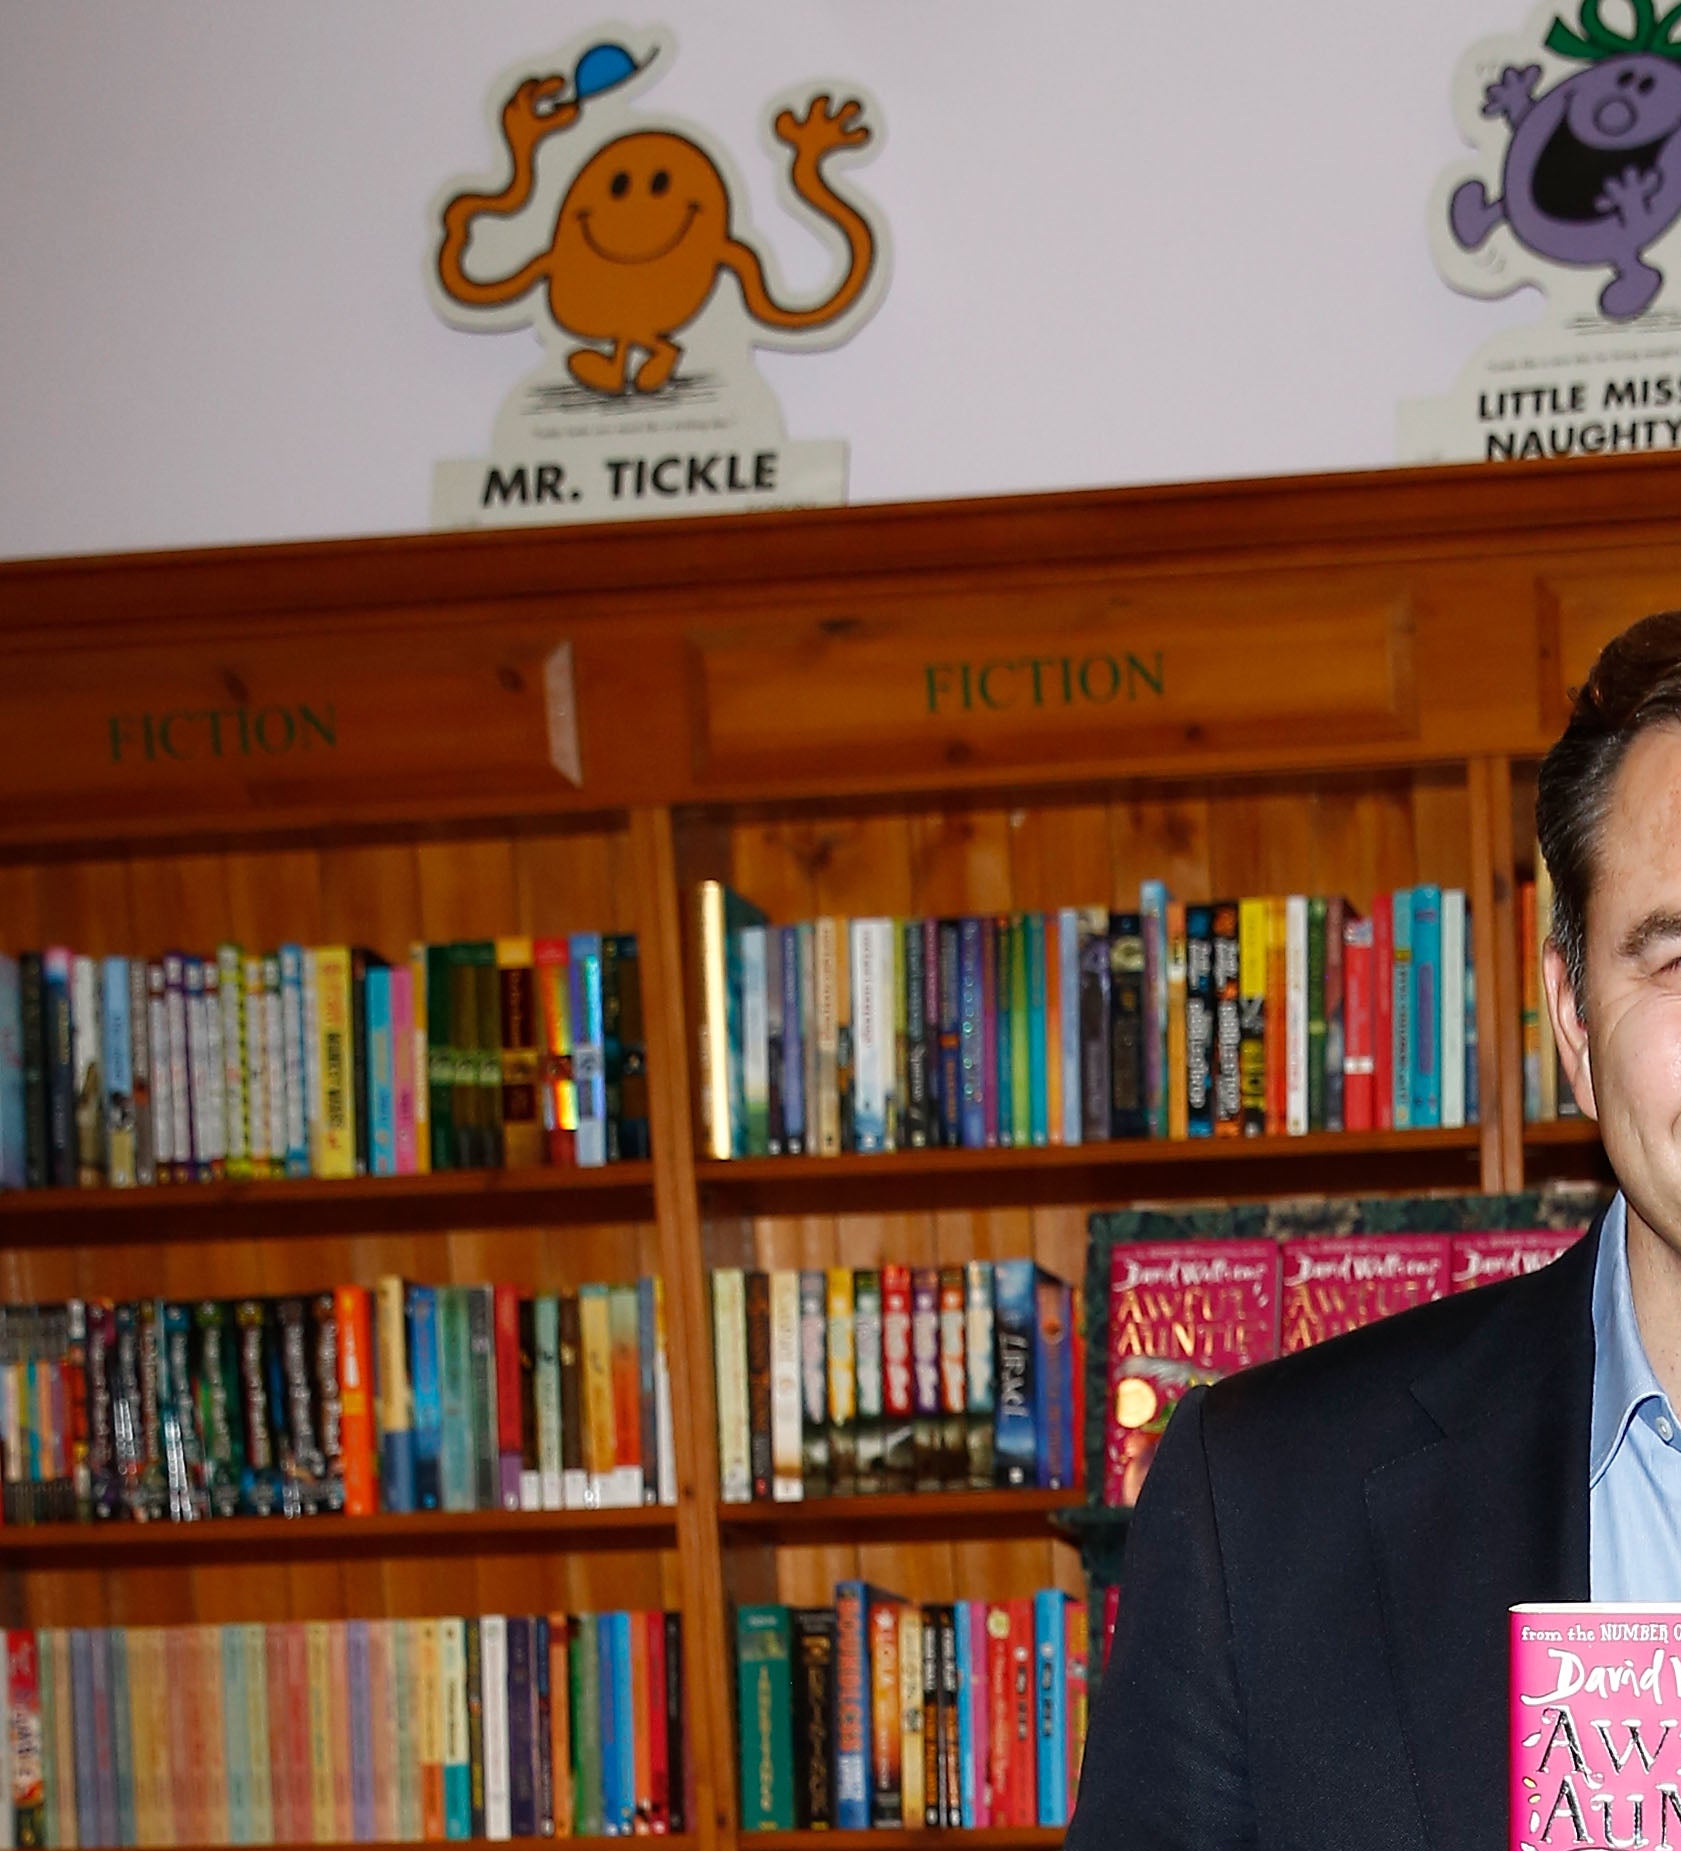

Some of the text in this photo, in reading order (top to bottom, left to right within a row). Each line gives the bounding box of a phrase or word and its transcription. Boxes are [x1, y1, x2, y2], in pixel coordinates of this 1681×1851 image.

[1478, 384, 1585, 421] LITTLE
[482, 453, 777, 508] MR. TICKLE
[924, 650, 1166, 715] FICTION
[108, 703, 338, 763] FICTION
[1521, 1626, 1562, 1642] from
[1567, 1627, 1595, 1642] the
[1600, 1623, 1669, 1644] NUMBER
[1520, 1647, 1665, 1707] David
